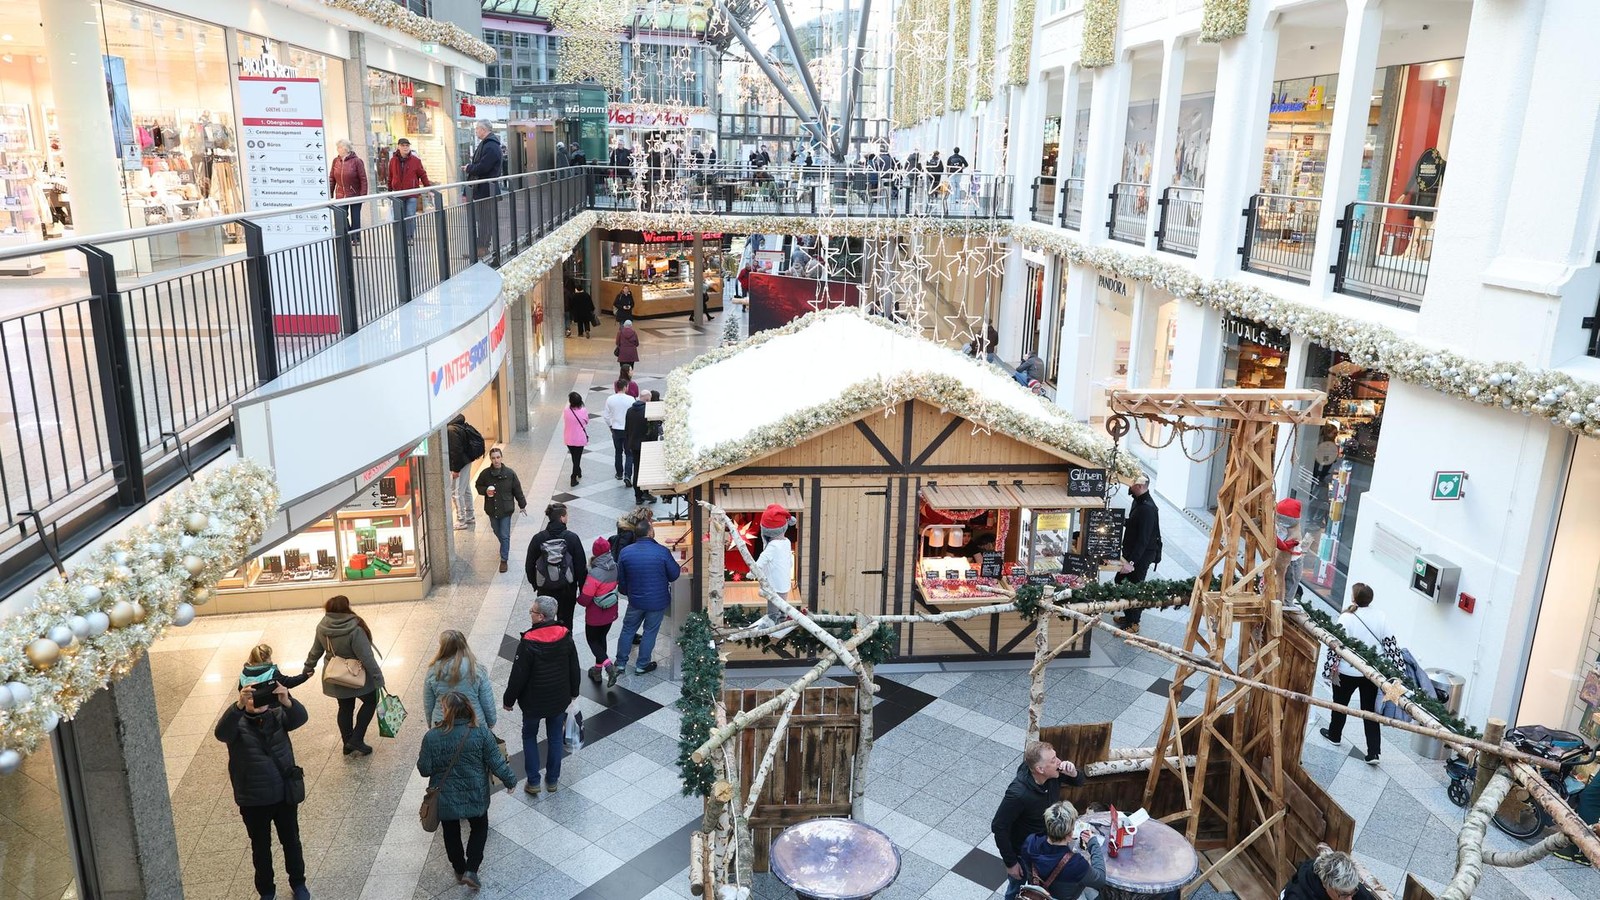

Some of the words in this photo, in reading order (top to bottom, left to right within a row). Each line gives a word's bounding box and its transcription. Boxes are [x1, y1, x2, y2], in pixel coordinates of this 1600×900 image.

[642, 231, 676, 242] Wiener
[1098, 274, 1126, 296] PANDORA
[444, 336, 488, 390] INTERSPORT
